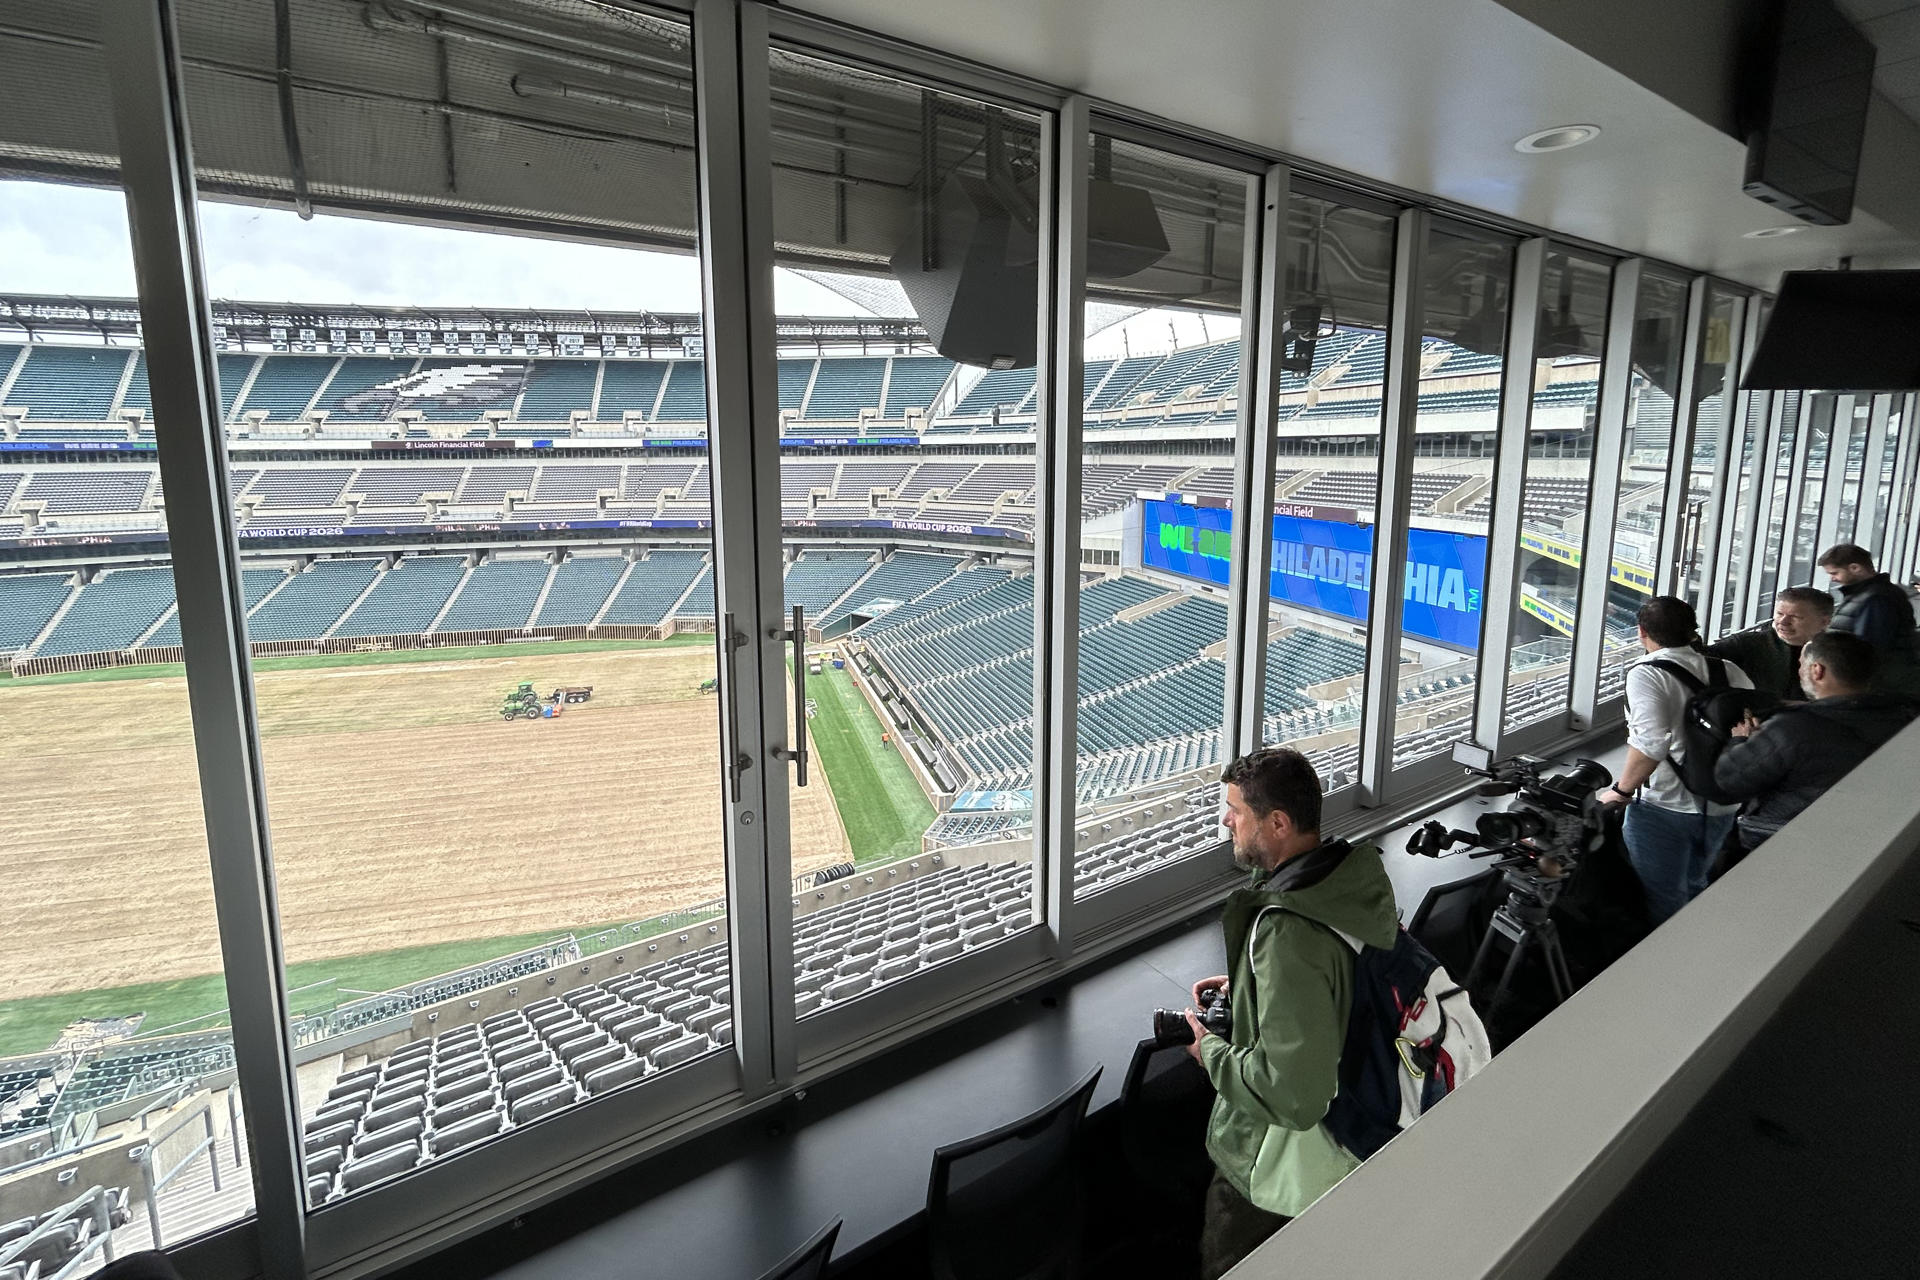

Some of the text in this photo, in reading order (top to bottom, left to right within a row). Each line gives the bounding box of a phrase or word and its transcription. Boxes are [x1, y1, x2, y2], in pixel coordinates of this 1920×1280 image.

[470, 440, 485, 448] Field
[1294, 506, 1314, 518] Field
[249, 529, 287, 537] WORLD
[287, 528, 308, 536] CUP
[309, 527, 344, 536] 2026
[436, 523, 501, 533] PHILAPHIA
[892, 521, 973, 534] FIFA WORLD CUP 2026
[18, 535, 113, 547] PHILAPHIA
[1467, 588, 1480, 613] TM
